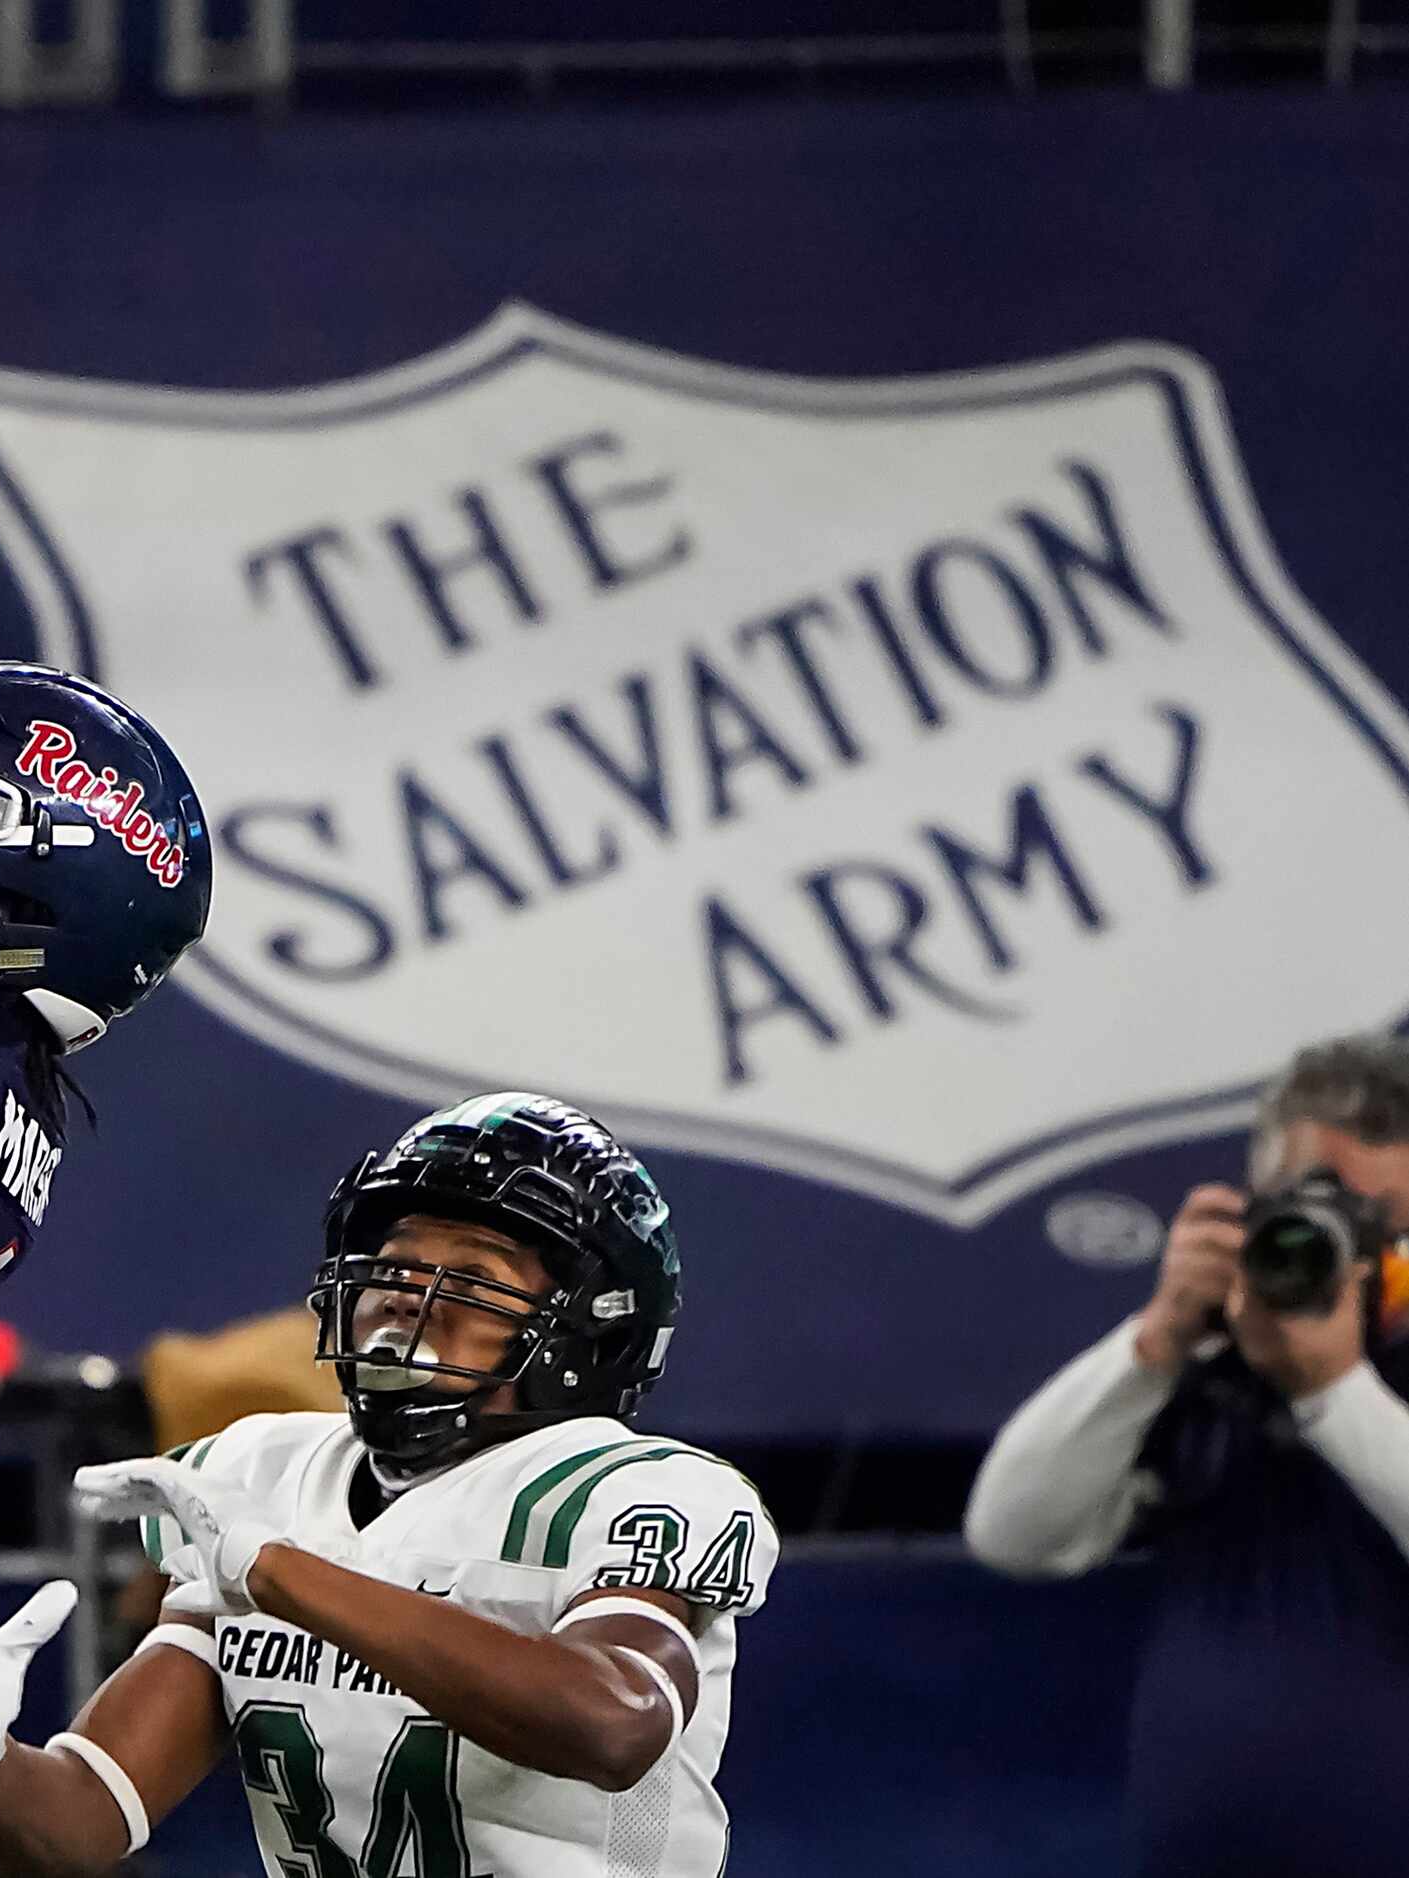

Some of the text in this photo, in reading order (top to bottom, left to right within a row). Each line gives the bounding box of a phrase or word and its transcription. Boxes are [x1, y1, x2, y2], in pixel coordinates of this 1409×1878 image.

[242, 428, 696, 690] THE
[15, 720, 184, 888] Raiders
[216, 456, 1178, 984] SALVATION
[700, 700, 1216, 1086] ARMY
[592, 1504, 755, 1611] 34
[218, 1625, 323, 1685] CEDAR
[232, 1699, 495, 1878] 34
